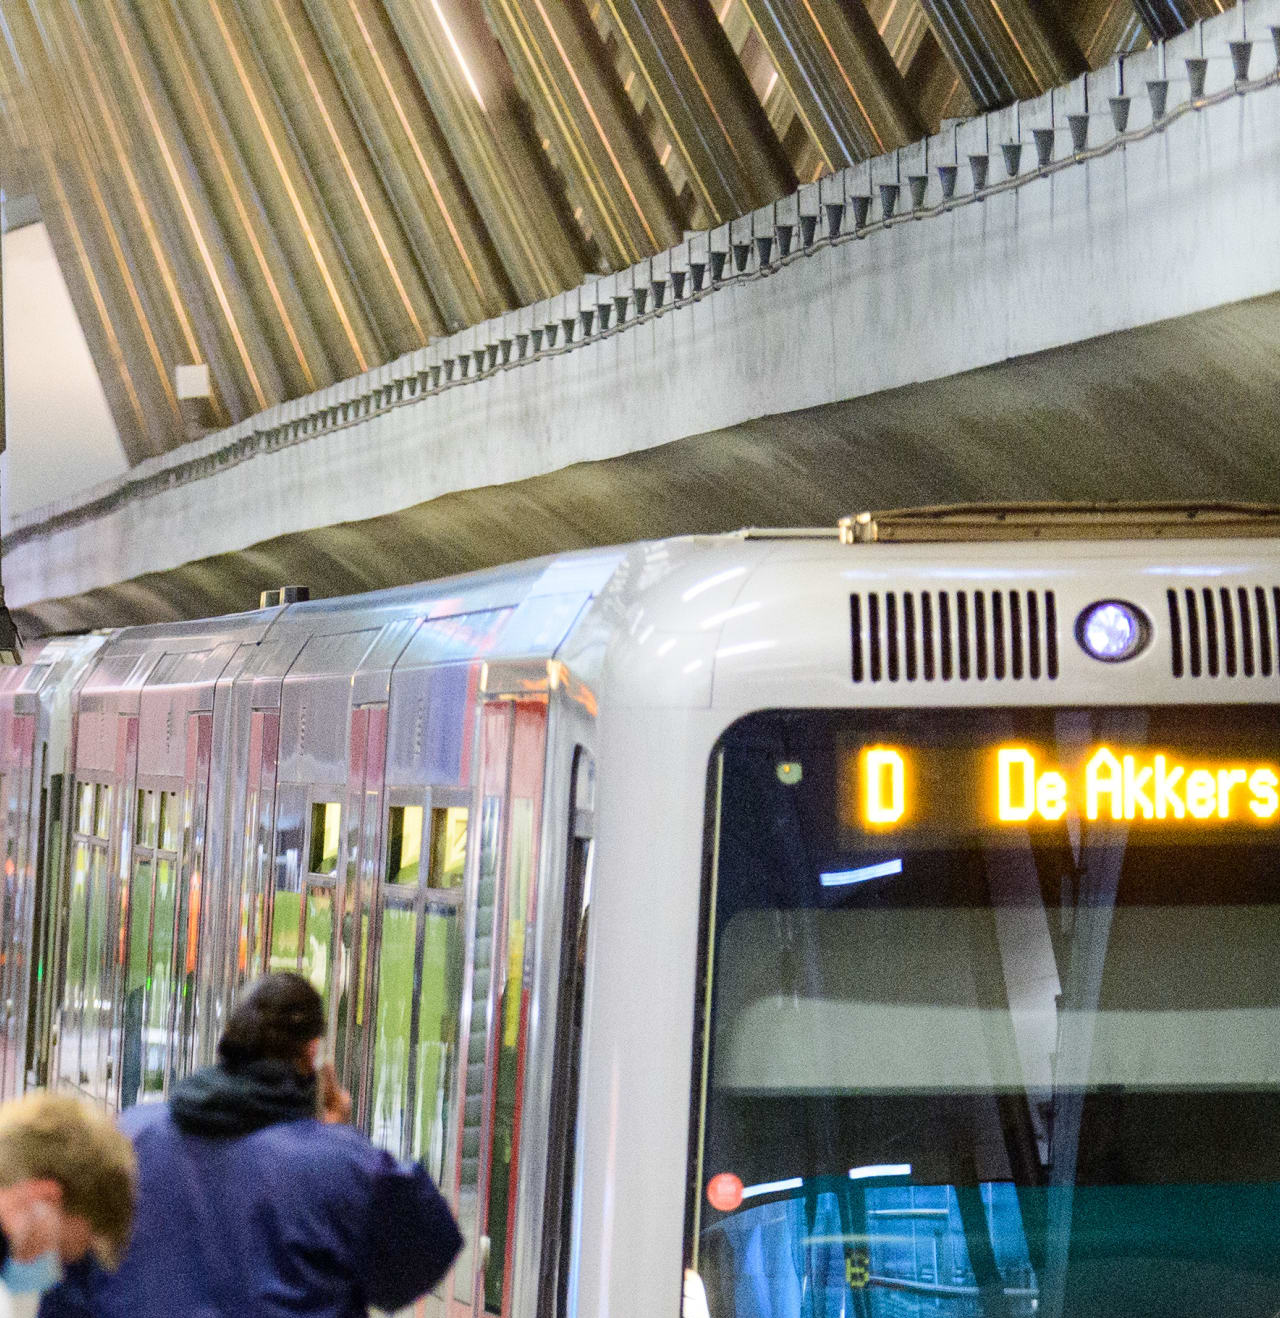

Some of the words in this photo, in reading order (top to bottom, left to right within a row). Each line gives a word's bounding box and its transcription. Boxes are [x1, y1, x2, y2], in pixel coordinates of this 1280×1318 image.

[864, 747, 906, 824] D
[995, 746, 1068, 822] De
[1084, 745, 1280, 820] Akkers
